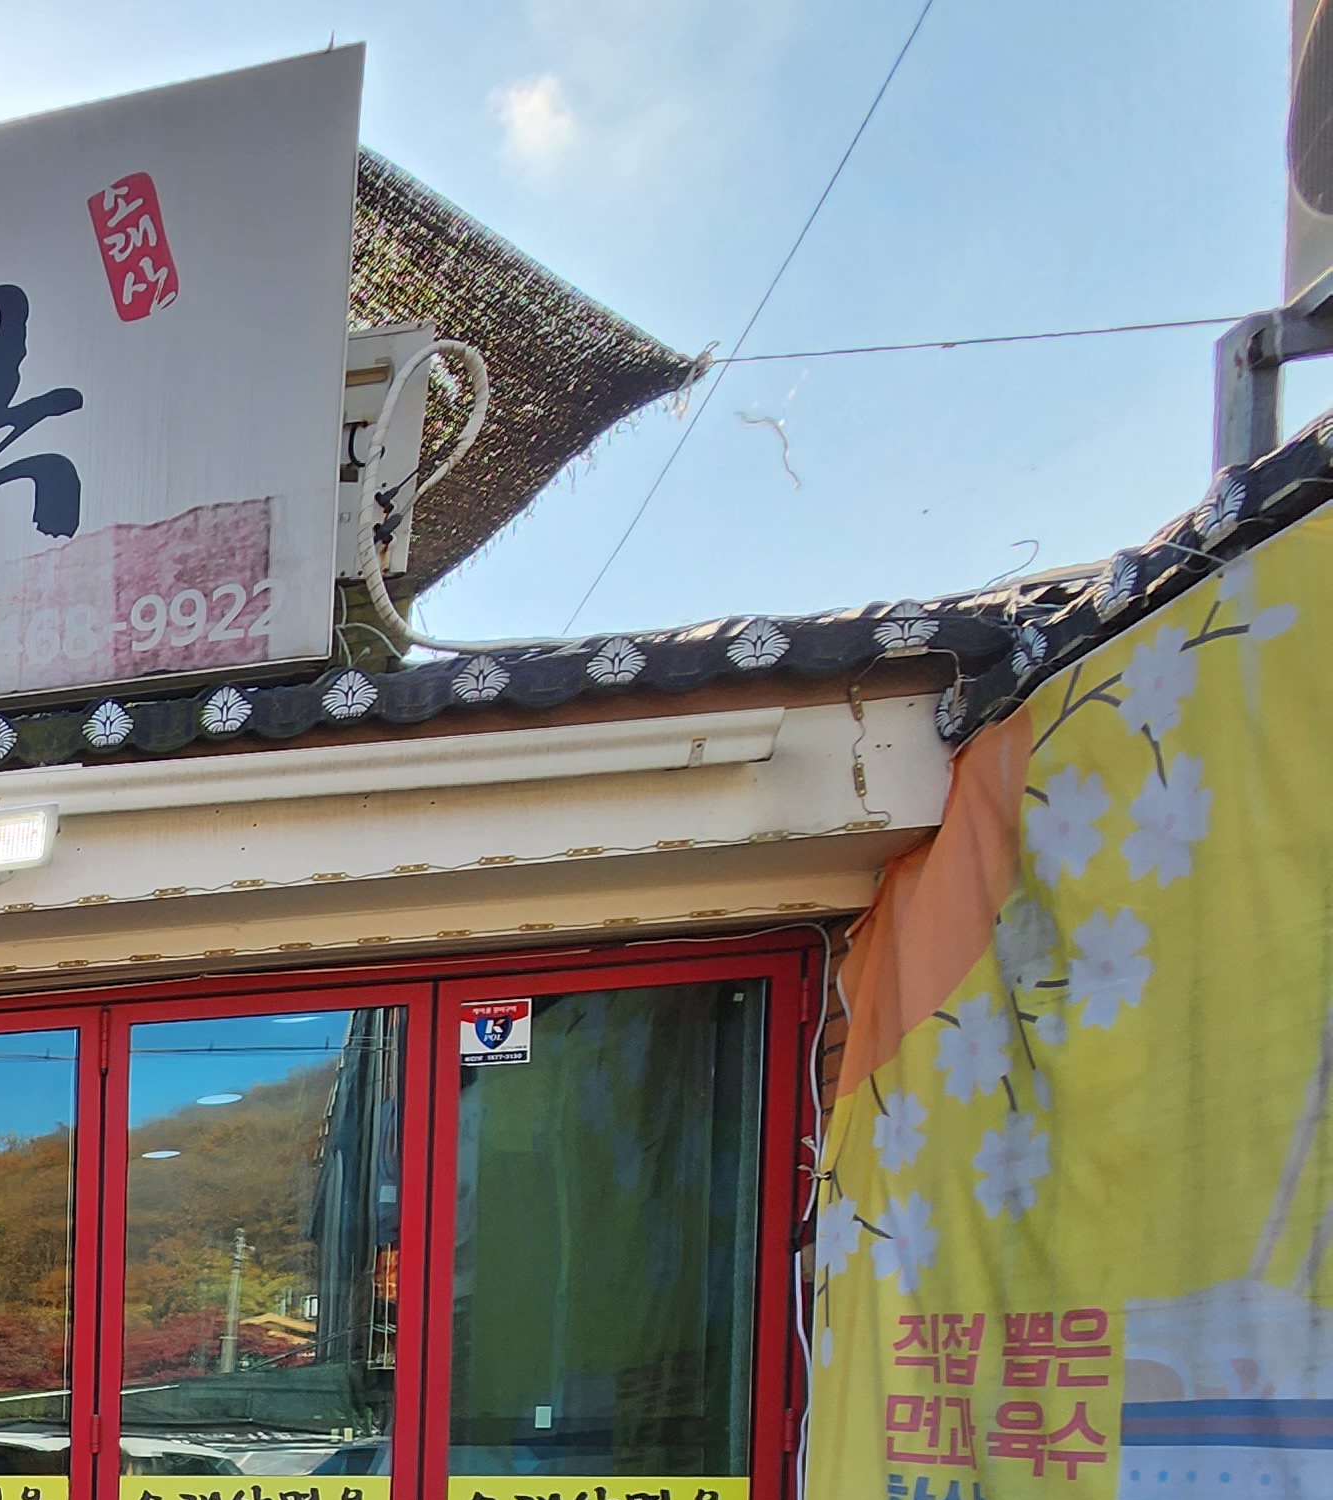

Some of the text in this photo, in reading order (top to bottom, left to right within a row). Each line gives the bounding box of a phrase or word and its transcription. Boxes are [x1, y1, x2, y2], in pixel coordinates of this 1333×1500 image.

[103, 187, 179, 316] 소래산
[893, 1307, 1112, 1388] 직접 뽑은
[884, 1394, 1108, 1481] 면과 육수
